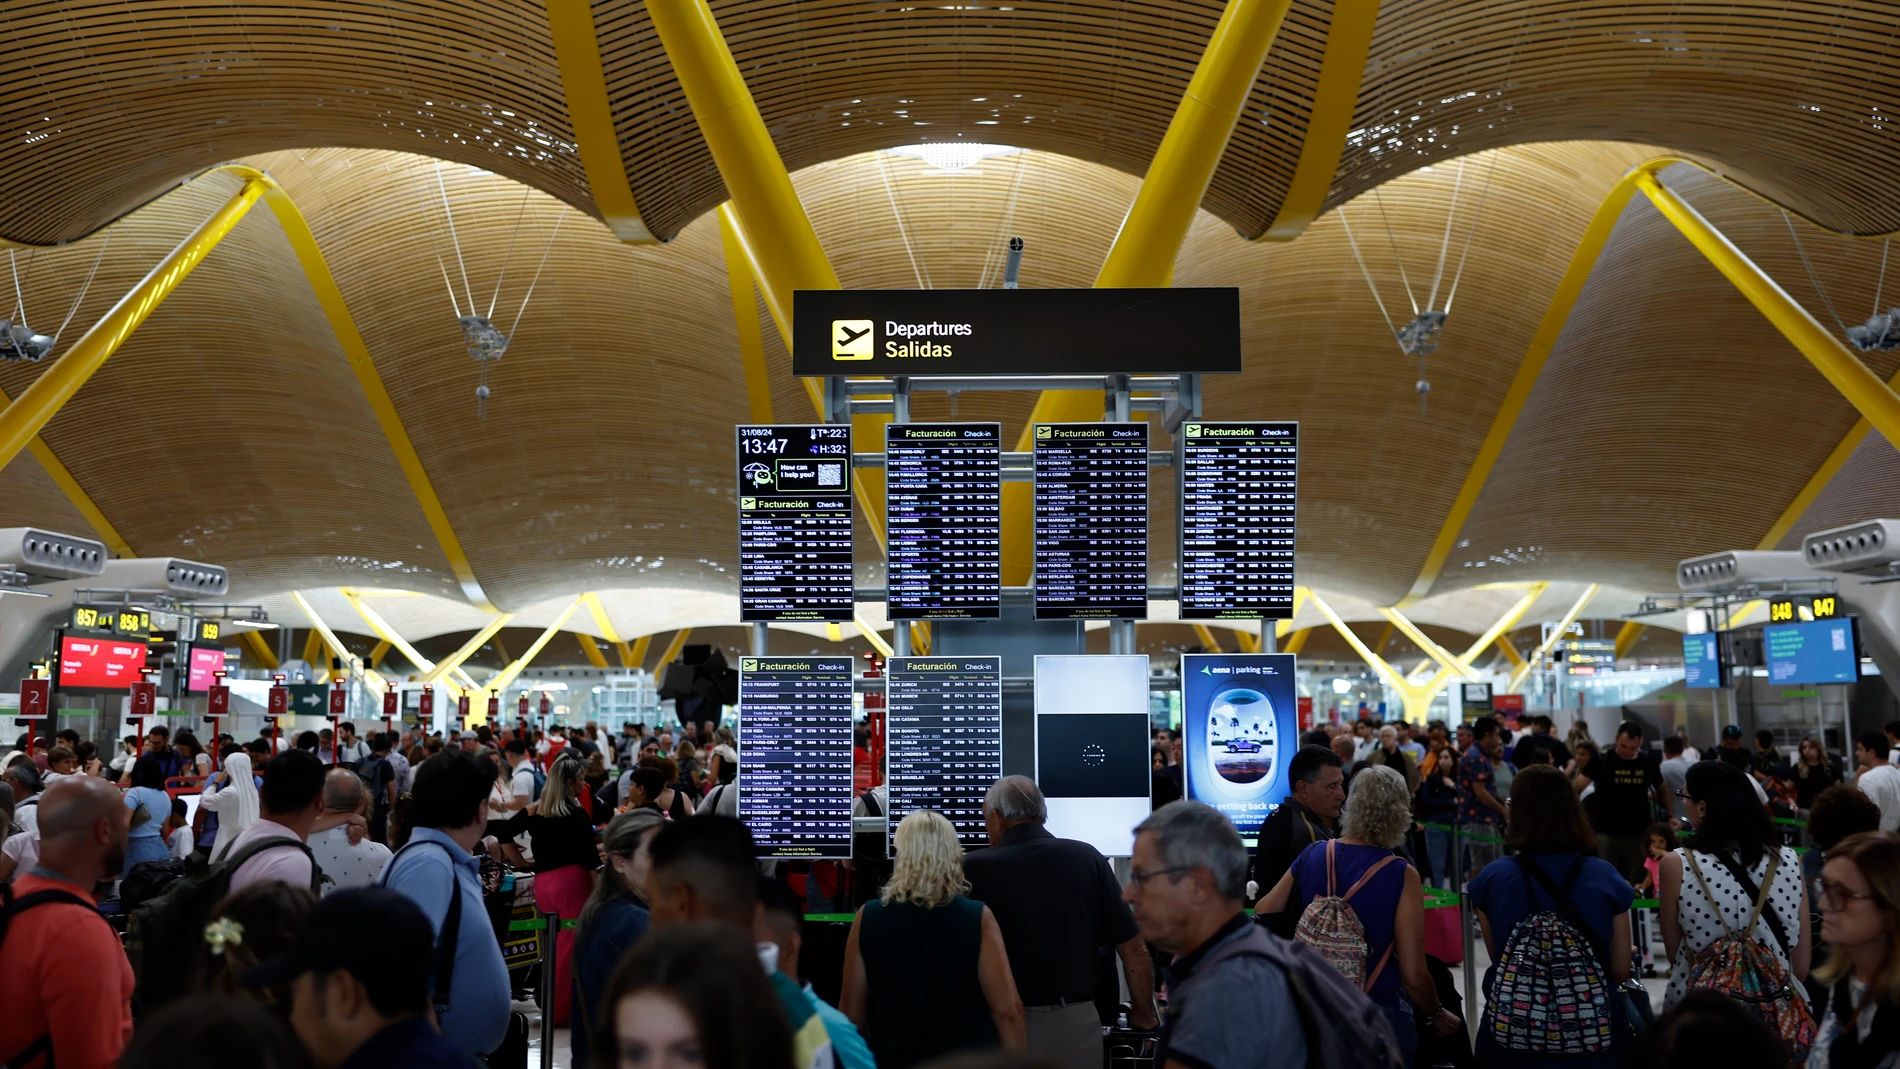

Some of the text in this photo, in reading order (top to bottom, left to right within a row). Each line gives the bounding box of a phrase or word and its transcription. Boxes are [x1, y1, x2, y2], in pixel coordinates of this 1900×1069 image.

[885, 321, 972, 339] Departures
[885, 341, 952, 358] Salidas
[742, 439, 788, 454] 13:47
[1813, 598, 1835, 616] 847
[76, 608, 98, 626] 857
[120, 614, 138, 631] 858
[203, 624, 218, 640] 859
[71, 644, 91, 652] IBERIA
[113, 647, 132, 655] IBERIA
[30, 691, 39, 704] 2
[139, 692, 147, 704] 3
[215, 695, 222, 705] 4
[275, 696, 281, 706] 5
[335, 697, 341, 707] 6
[388, 699, 394, 708] 7
[1217, 803, 1247, 811] getting
